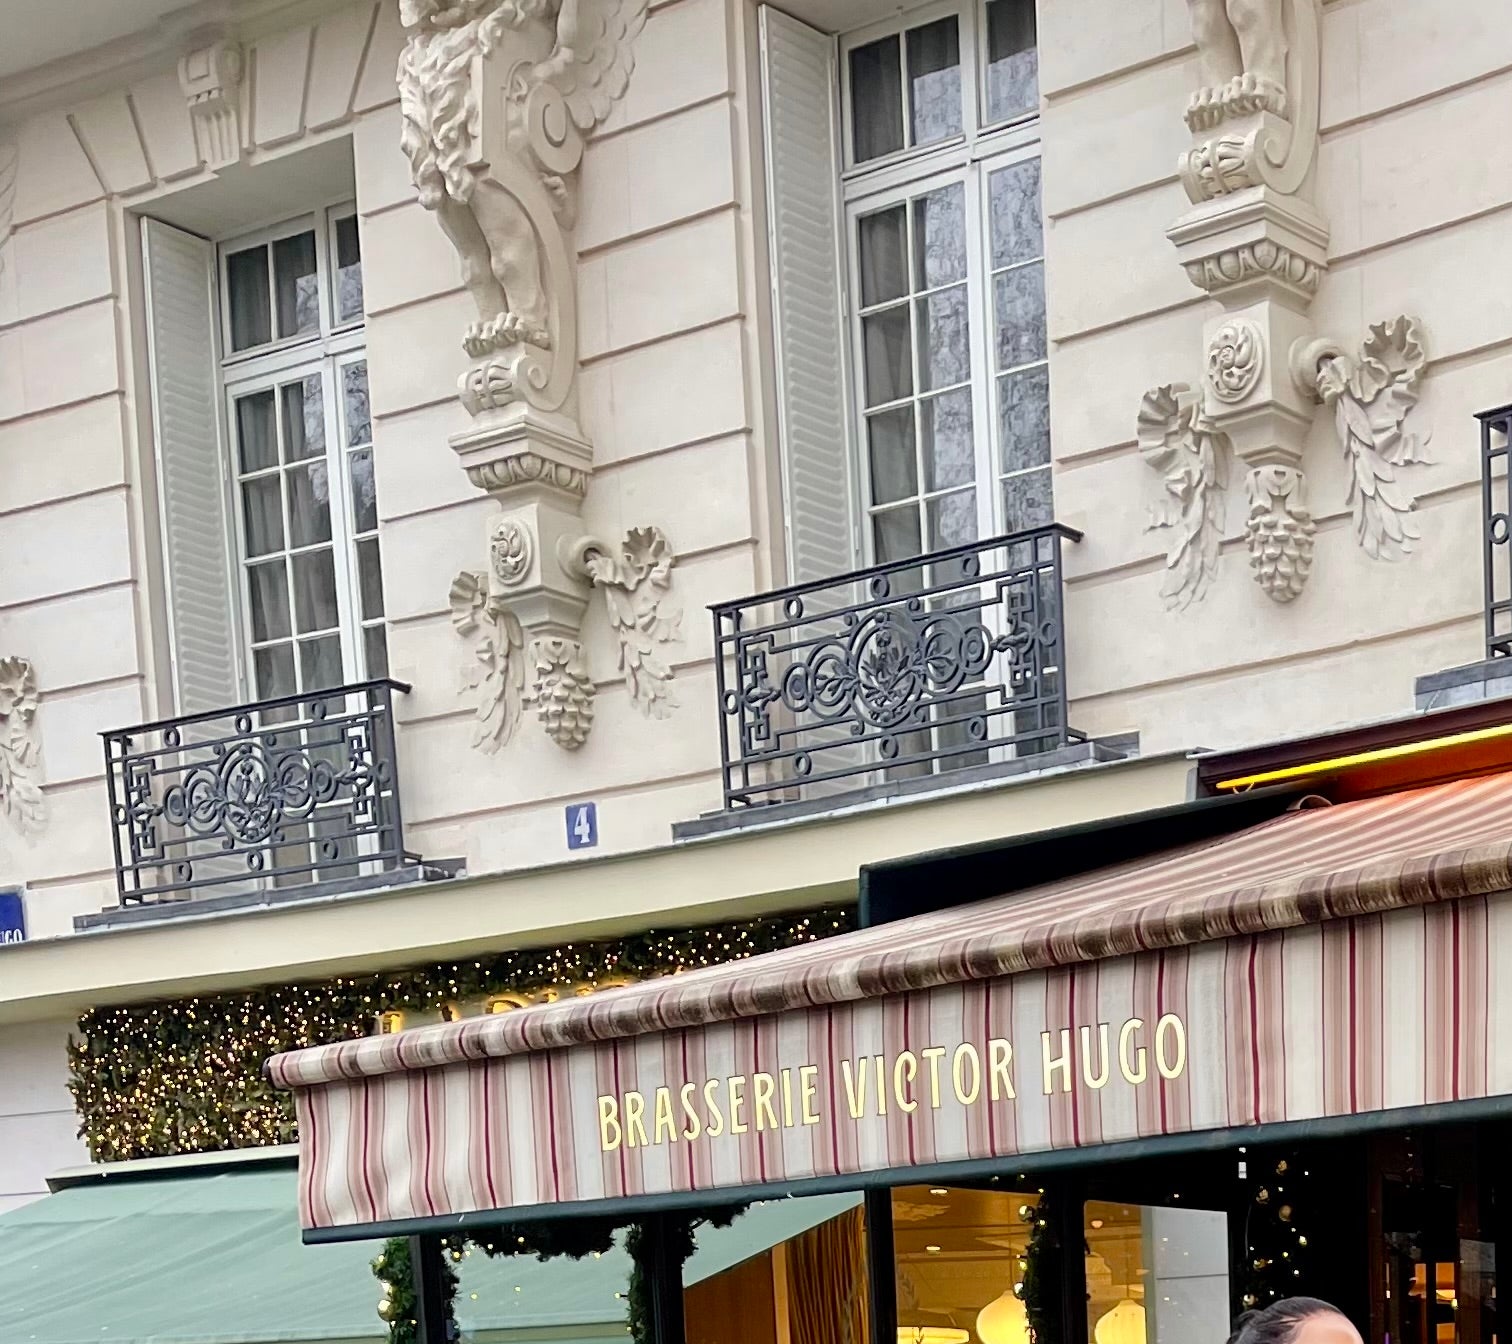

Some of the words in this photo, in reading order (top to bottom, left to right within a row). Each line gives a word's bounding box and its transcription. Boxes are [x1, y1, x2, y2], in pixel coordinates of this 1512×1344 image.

[574, 806, 590, 843] 4
[597, 1064, 821, 1152] BRASSERIE
[841, 1037, 1017, 1119] VICTOR
[1040, 1012, 1187, 1095] HUGO
